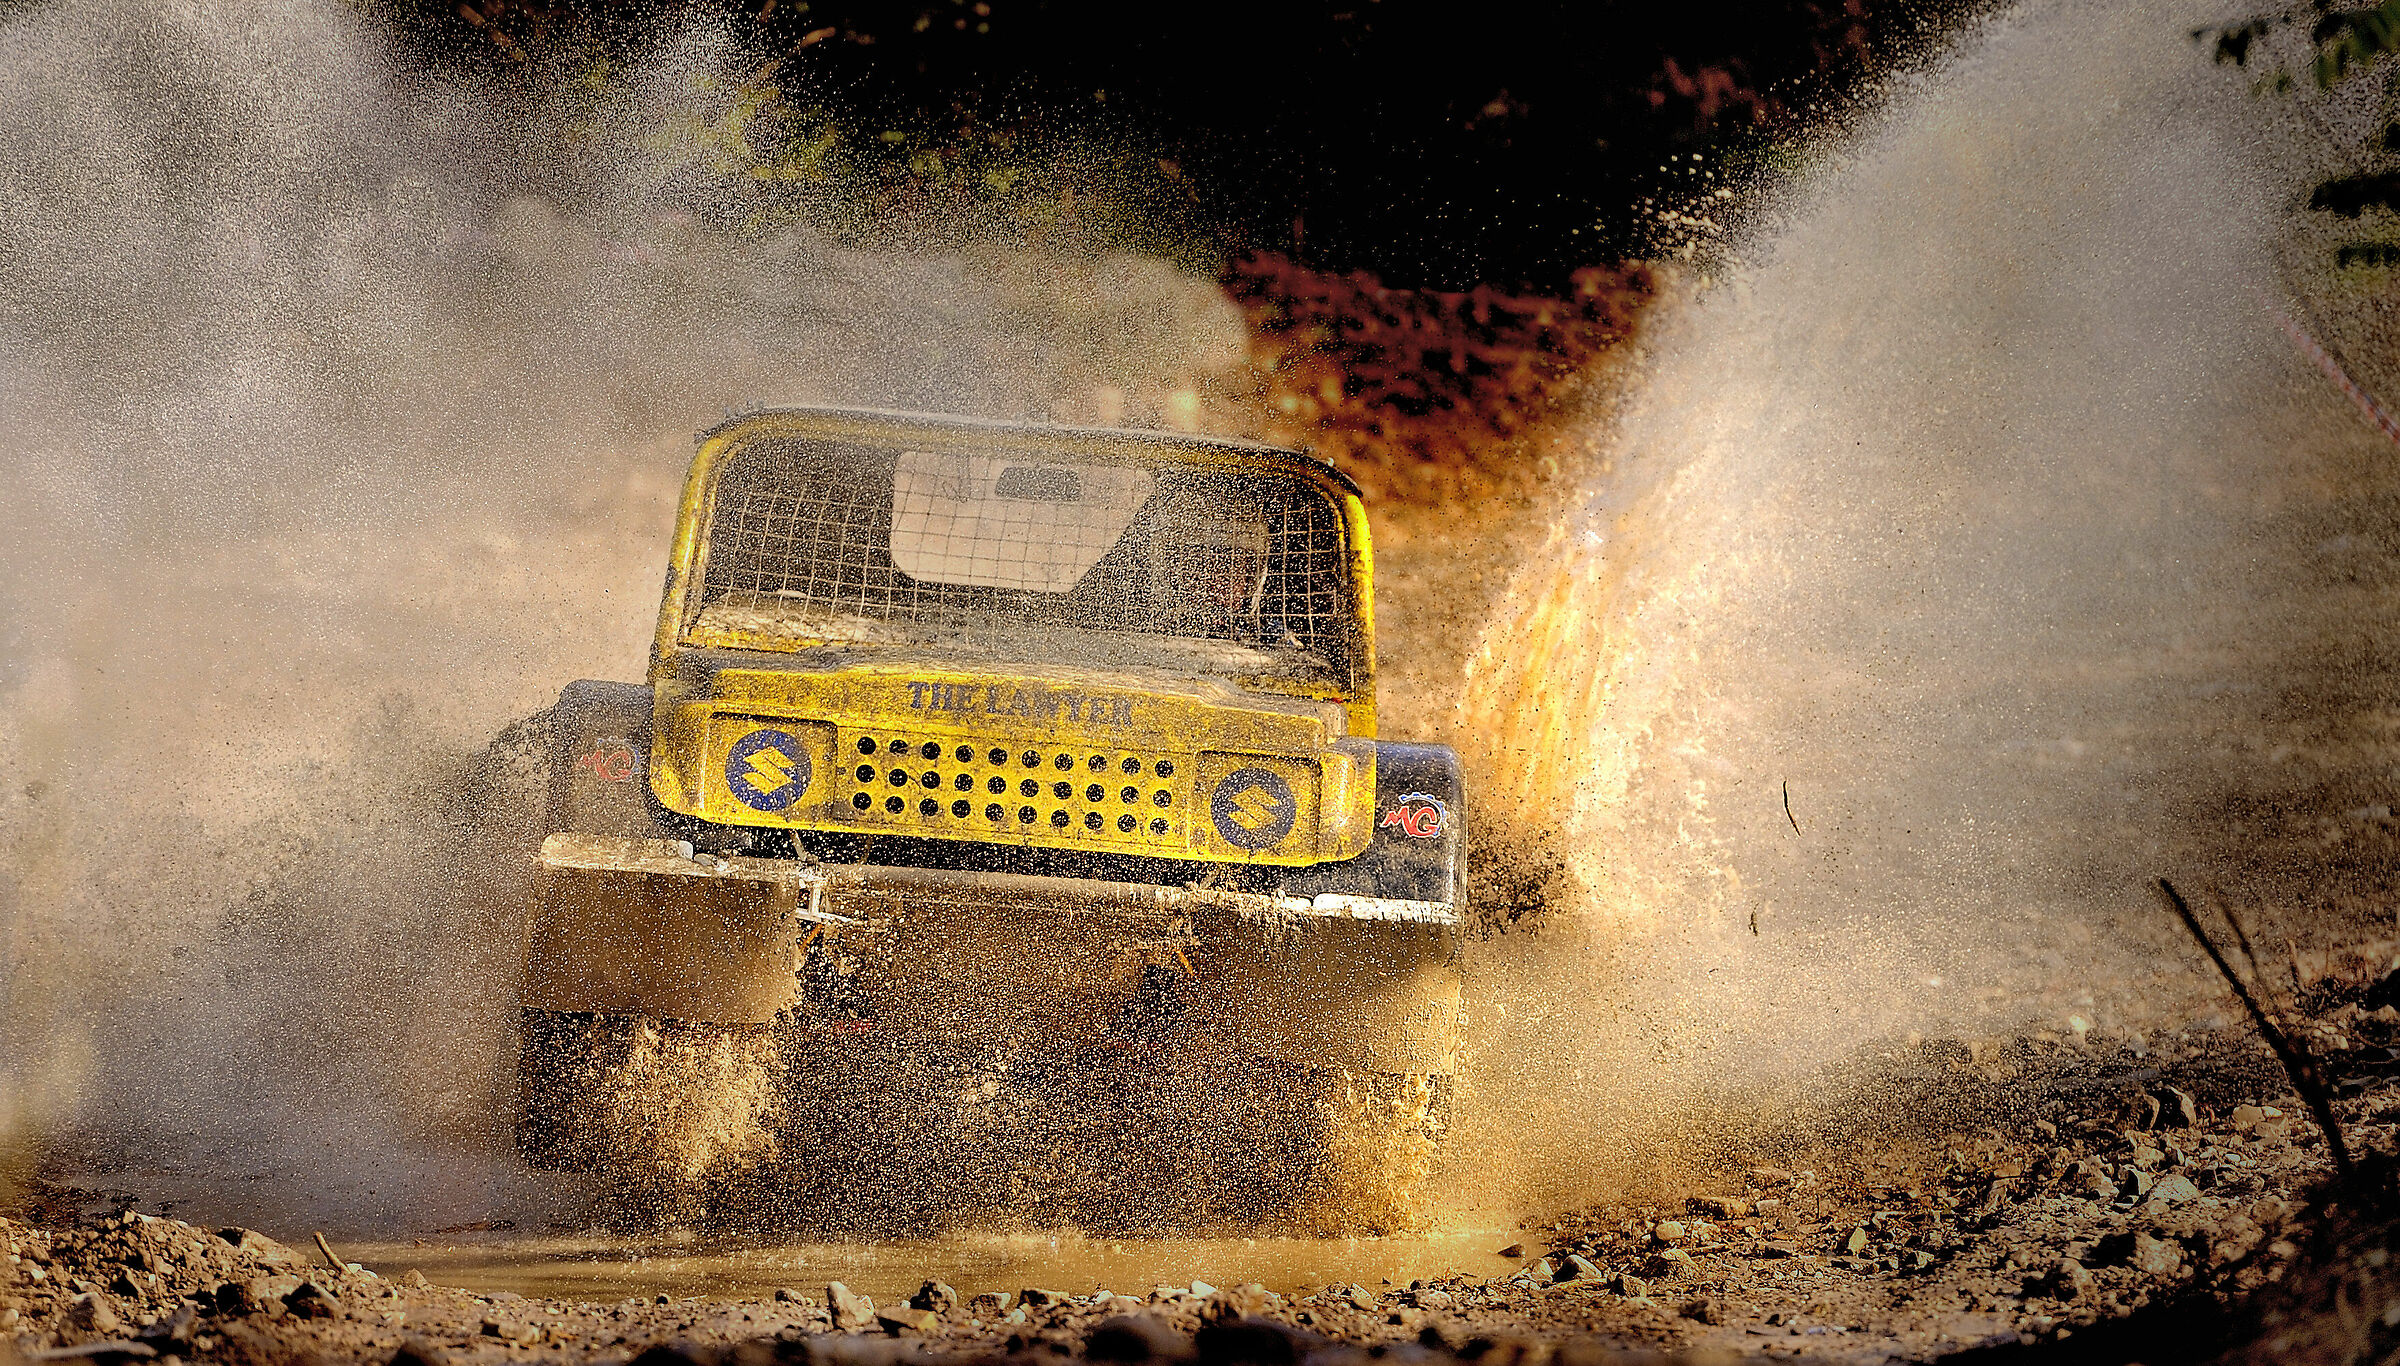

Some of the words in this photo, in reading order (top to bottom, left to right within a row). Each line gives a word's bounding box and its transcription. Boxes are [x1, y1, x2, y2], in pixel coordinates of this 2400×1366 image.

[907, 680, 979, 713] THE
[985, 683, 1133, 727] LAWYER
[1379, 805, 1440, 837] MG
